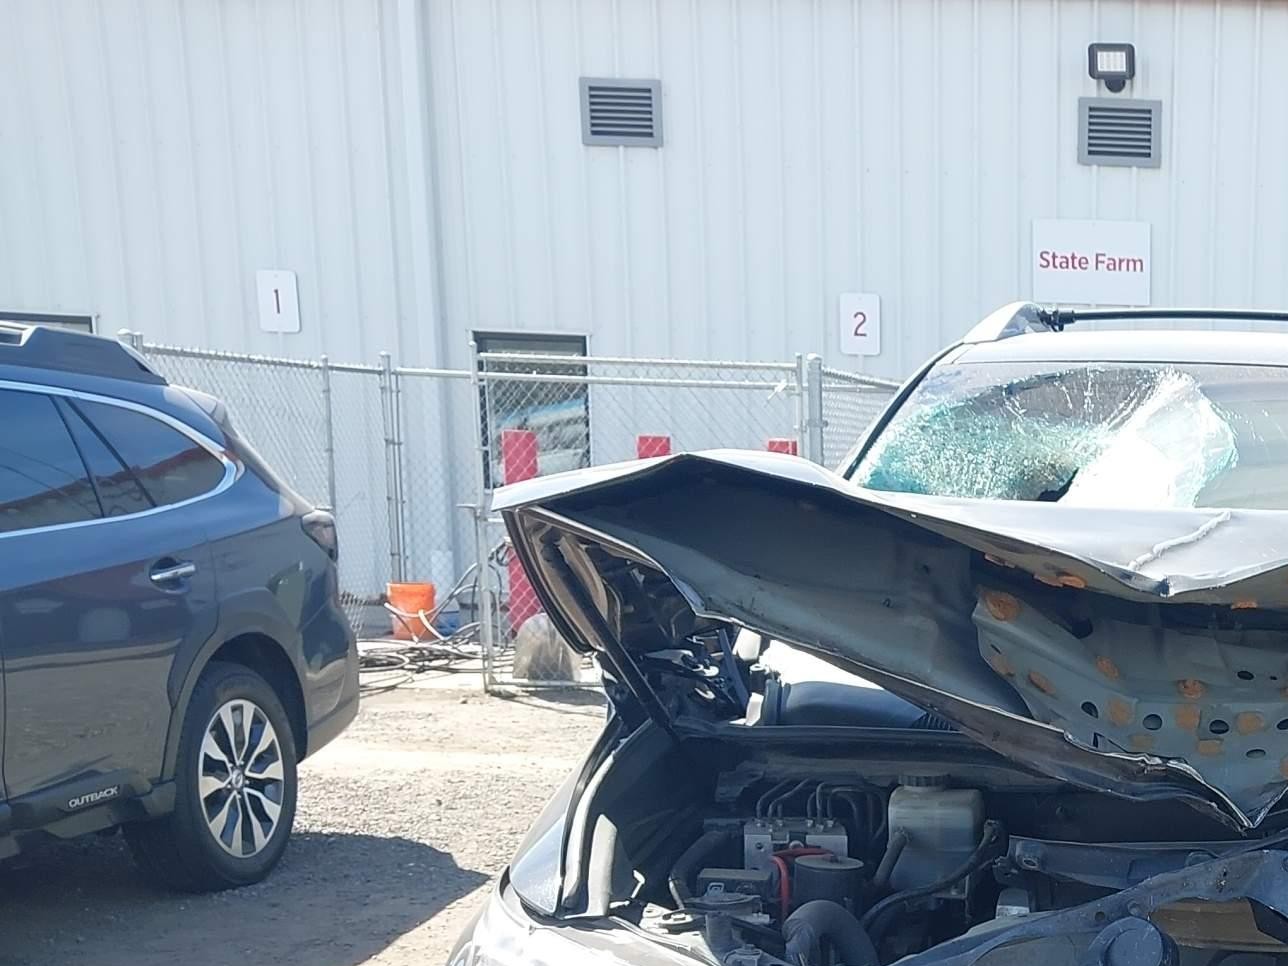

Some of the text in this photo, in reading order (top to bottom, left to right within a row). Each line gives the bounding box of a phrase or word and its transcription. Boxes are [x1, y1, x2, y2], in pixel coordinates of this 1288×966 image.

[1039, 250, 1144, 273] State Farm
[273, 288, 281, 315] 1
[853, 311, 867, 337] 2
[68, 786, 118, 808] OUTBACK
